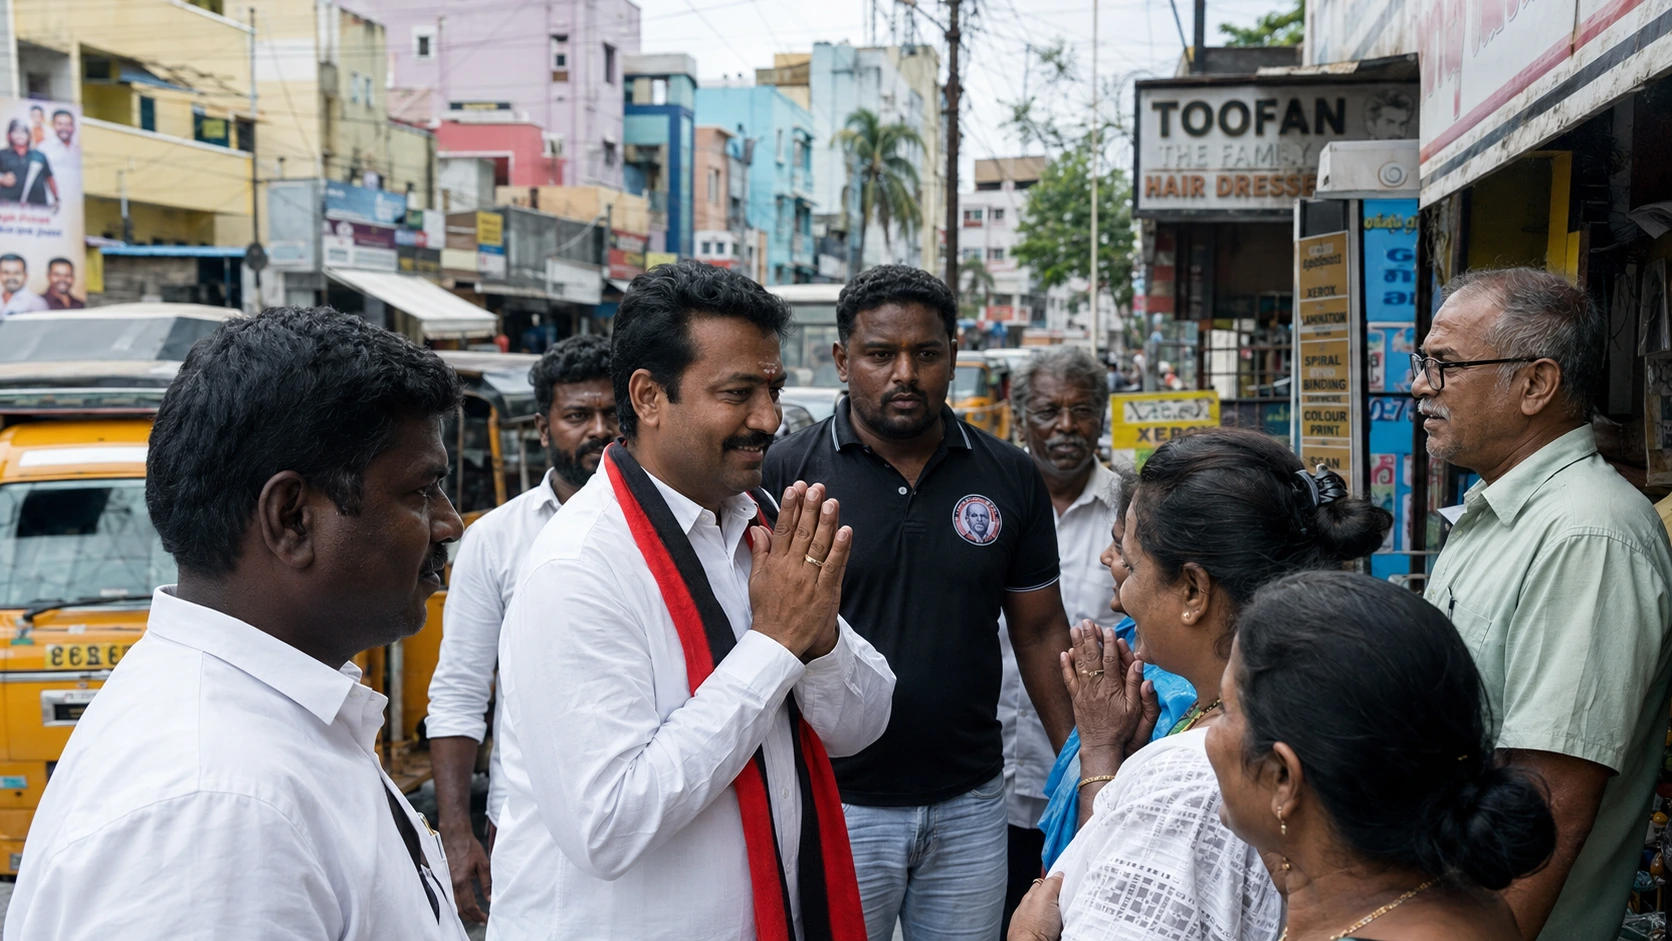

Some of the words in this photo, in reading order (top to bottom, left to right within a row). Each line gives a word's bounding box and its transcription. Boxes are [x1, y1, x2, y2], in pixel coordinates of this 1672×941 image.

[1151, 97, 1346, 137] TOOFAN
[1158, 144, 1208, 168] THE
[1145, 174, 1206, 198] HAIR
[1216, 173, 1317, 198] DRESSE
[1307, 285, 1337, 298] XEROX
[1305, 355, 1341, 367] SPIRAL
[1303, 379, 1346, 390] BINDING
[1304, 411, 1347, 422] COLOUR
[1137, 426, 1200, 442] XER
[1310, 425, 1340, 436] PRINT
[1310, 456, 1340, 469] SCAN
